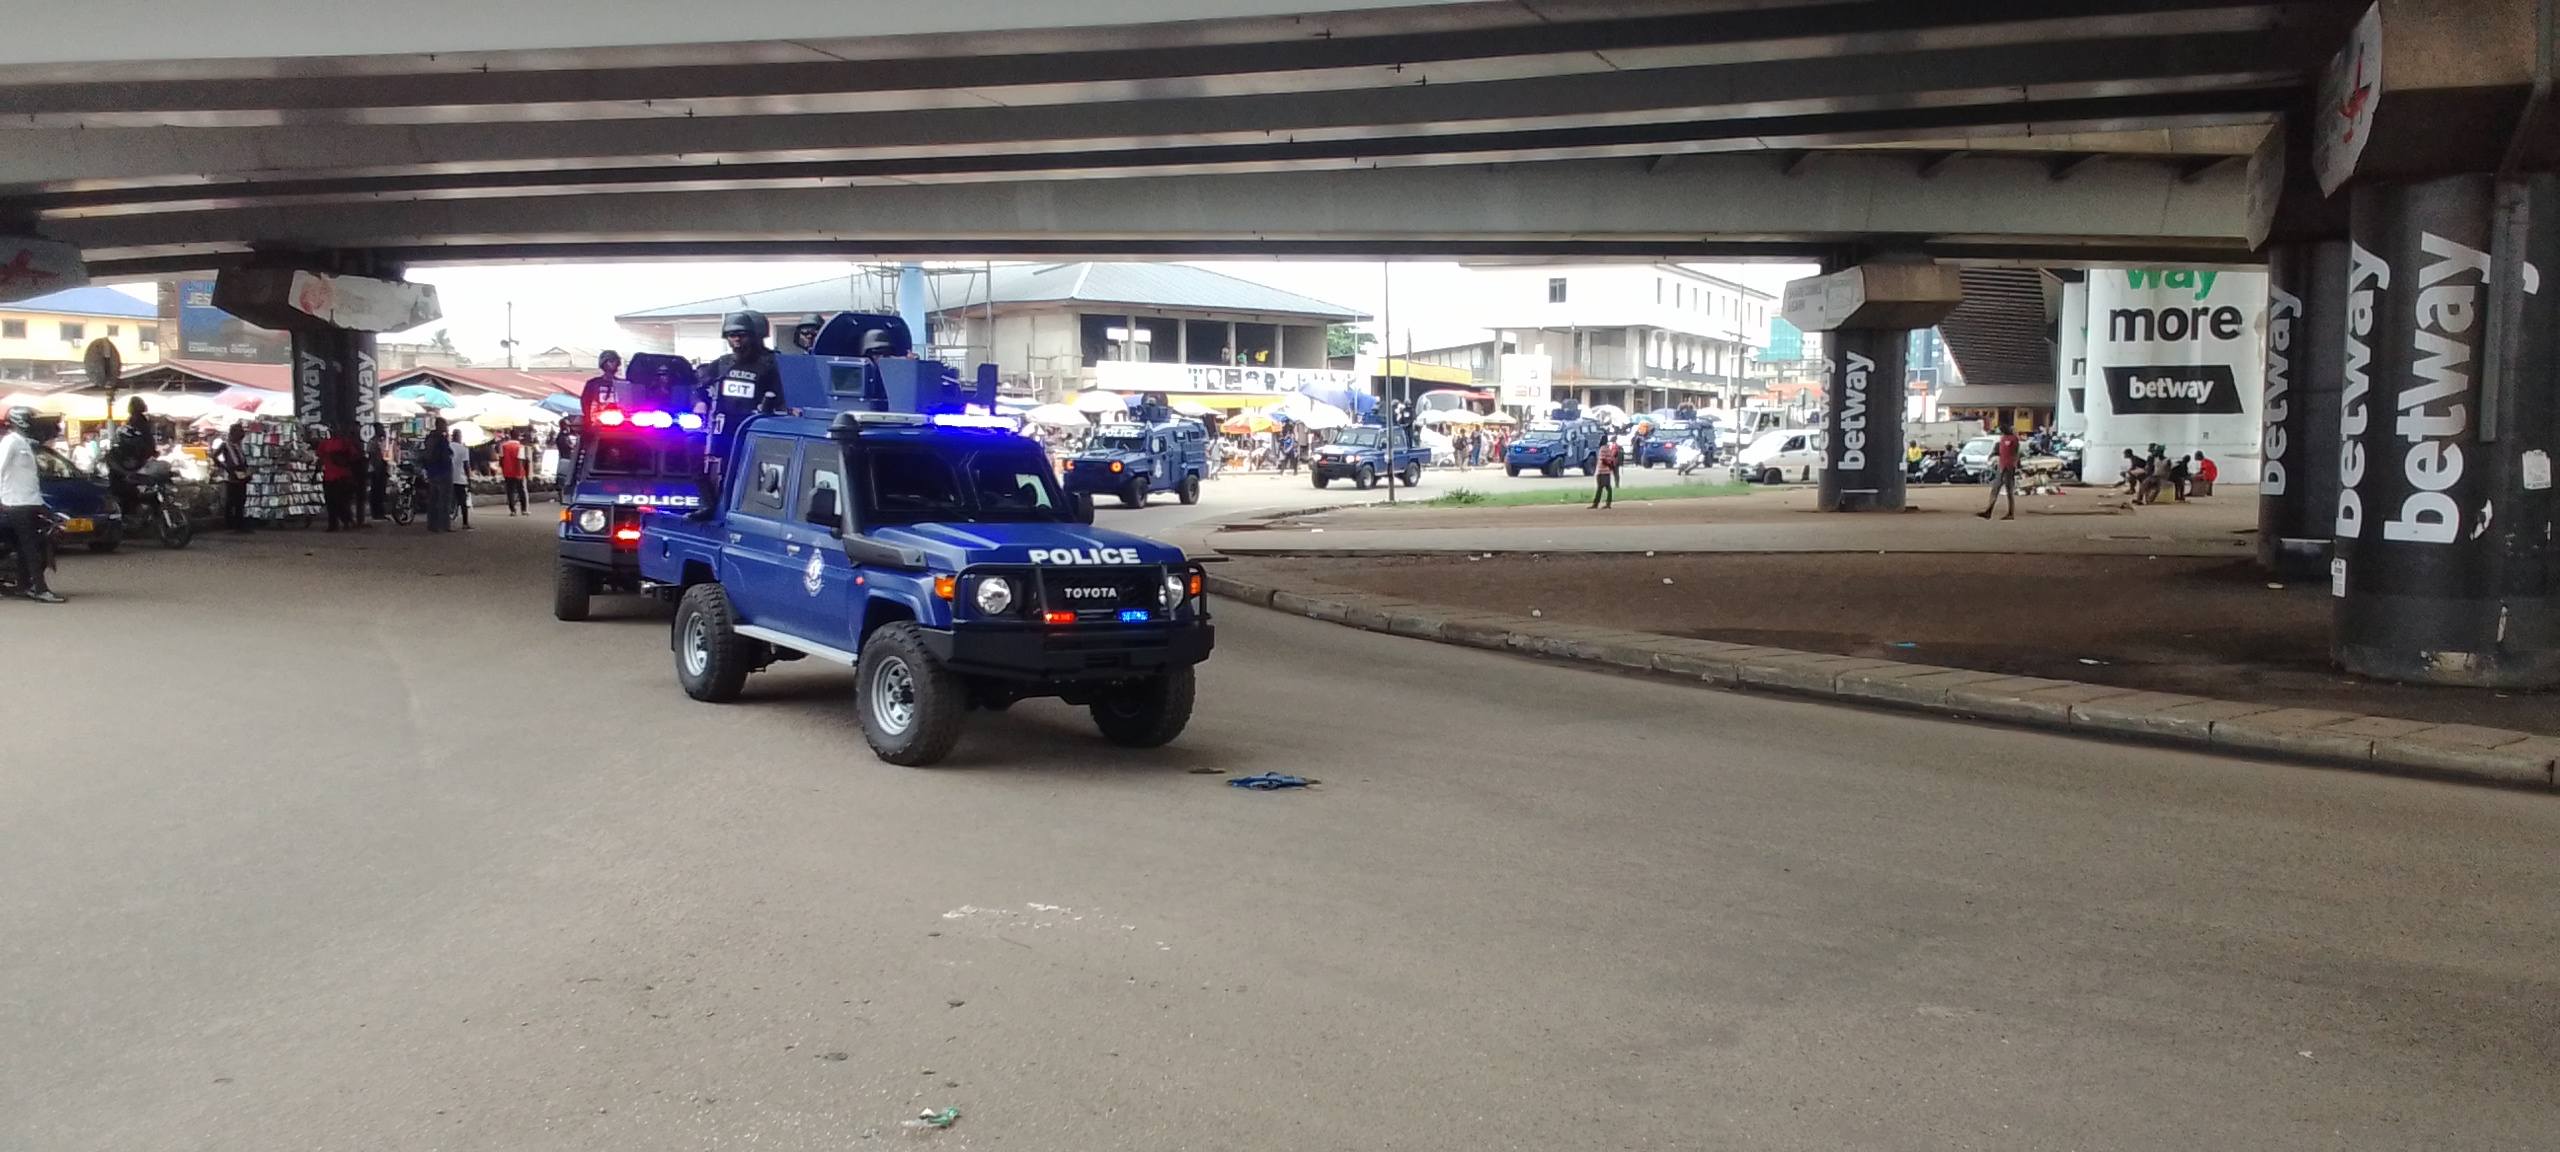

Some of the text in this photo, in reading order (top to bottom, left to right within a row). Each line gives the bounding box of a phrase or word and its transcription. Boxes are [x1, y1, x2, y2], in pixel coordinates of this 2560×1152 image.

[2126, 270, 2219, 301] way
[2109, 306, 2243, 341] more
[301, 350, 326, 425] tway
[728, 383, 751, 395] CIT
[729, 370, 757, 381] OLICE
[2129, 376, 2214, 404] betway
[2261, 284, 2302, 495] betway
[2336, 240, 2390, 538] betway
[2384, 231, 2492, 543] betway
[356, 350, 376, 443] etway
[1838, 351, 1875, 470] betway
[618, 494, 700, 507] POLICE
[1028, 548, 1141, 565] POLICE
[1063, 587, 1118, 598] TOYOTA
